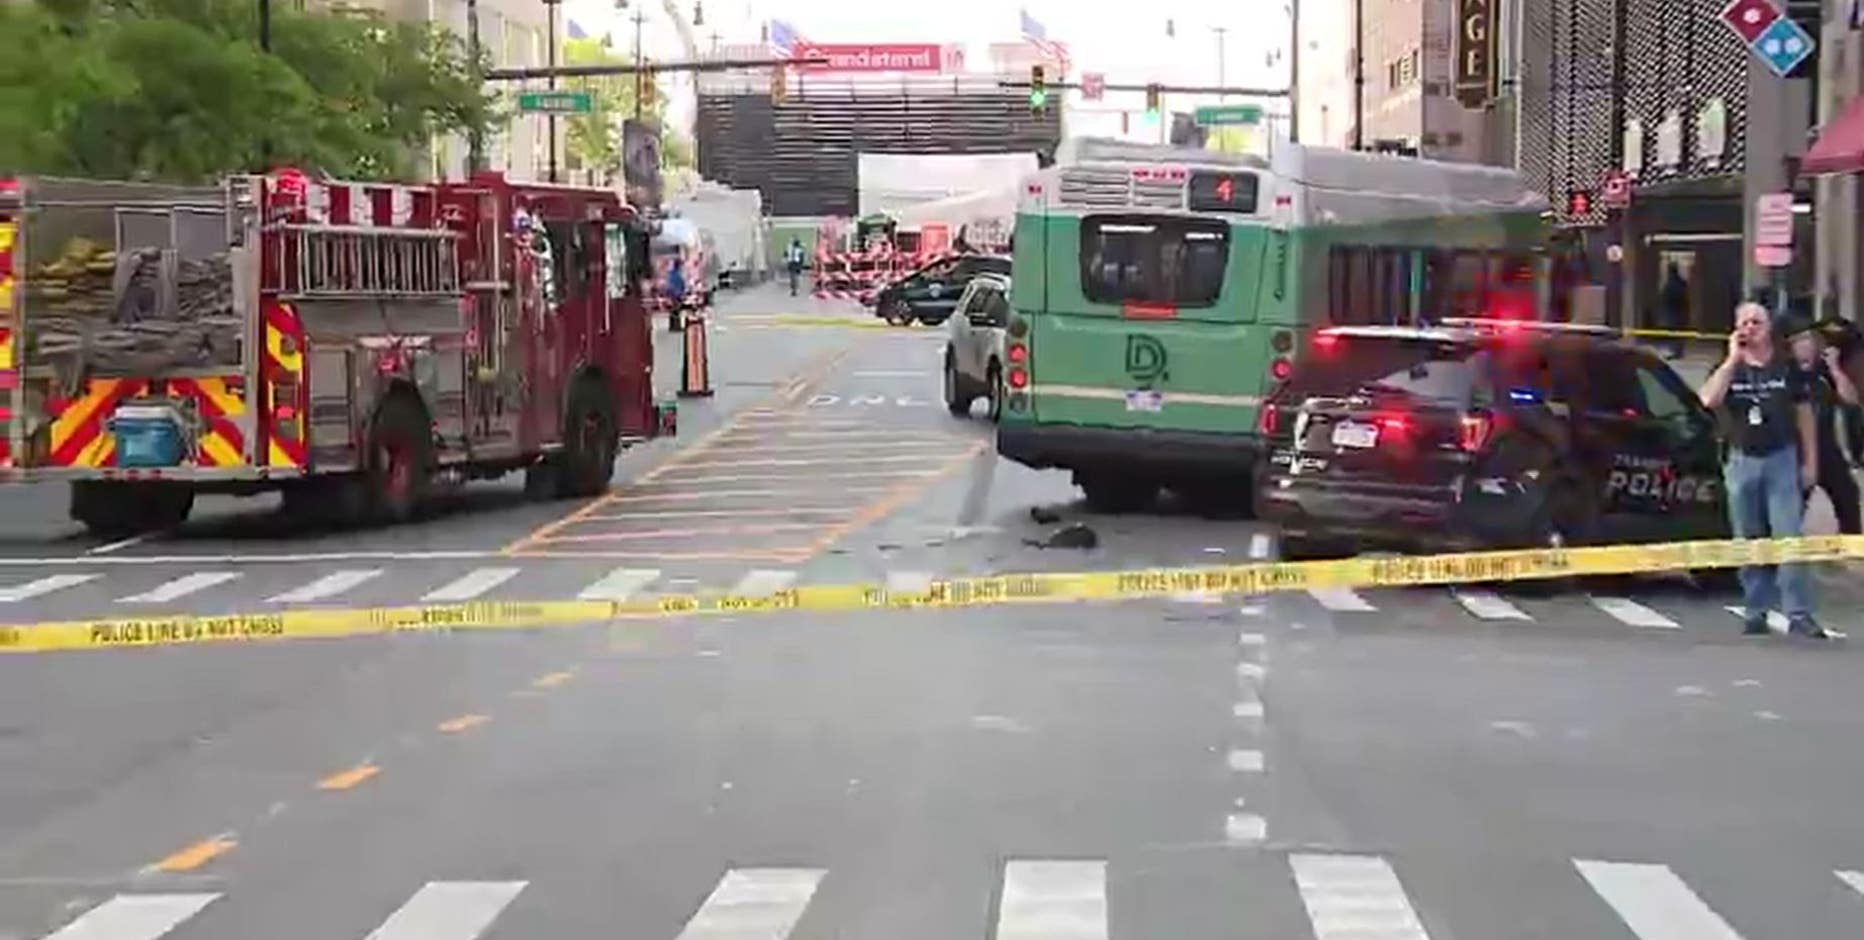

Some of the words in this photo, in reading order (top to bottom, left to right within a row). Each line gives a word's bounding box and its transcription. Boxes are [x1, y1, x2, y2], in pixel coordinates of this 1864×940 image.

[1216, 178, 1233, 202] 4
[1606, 470, 1717, 502] POLICE
[91, 622, 142, 643] POLICE
